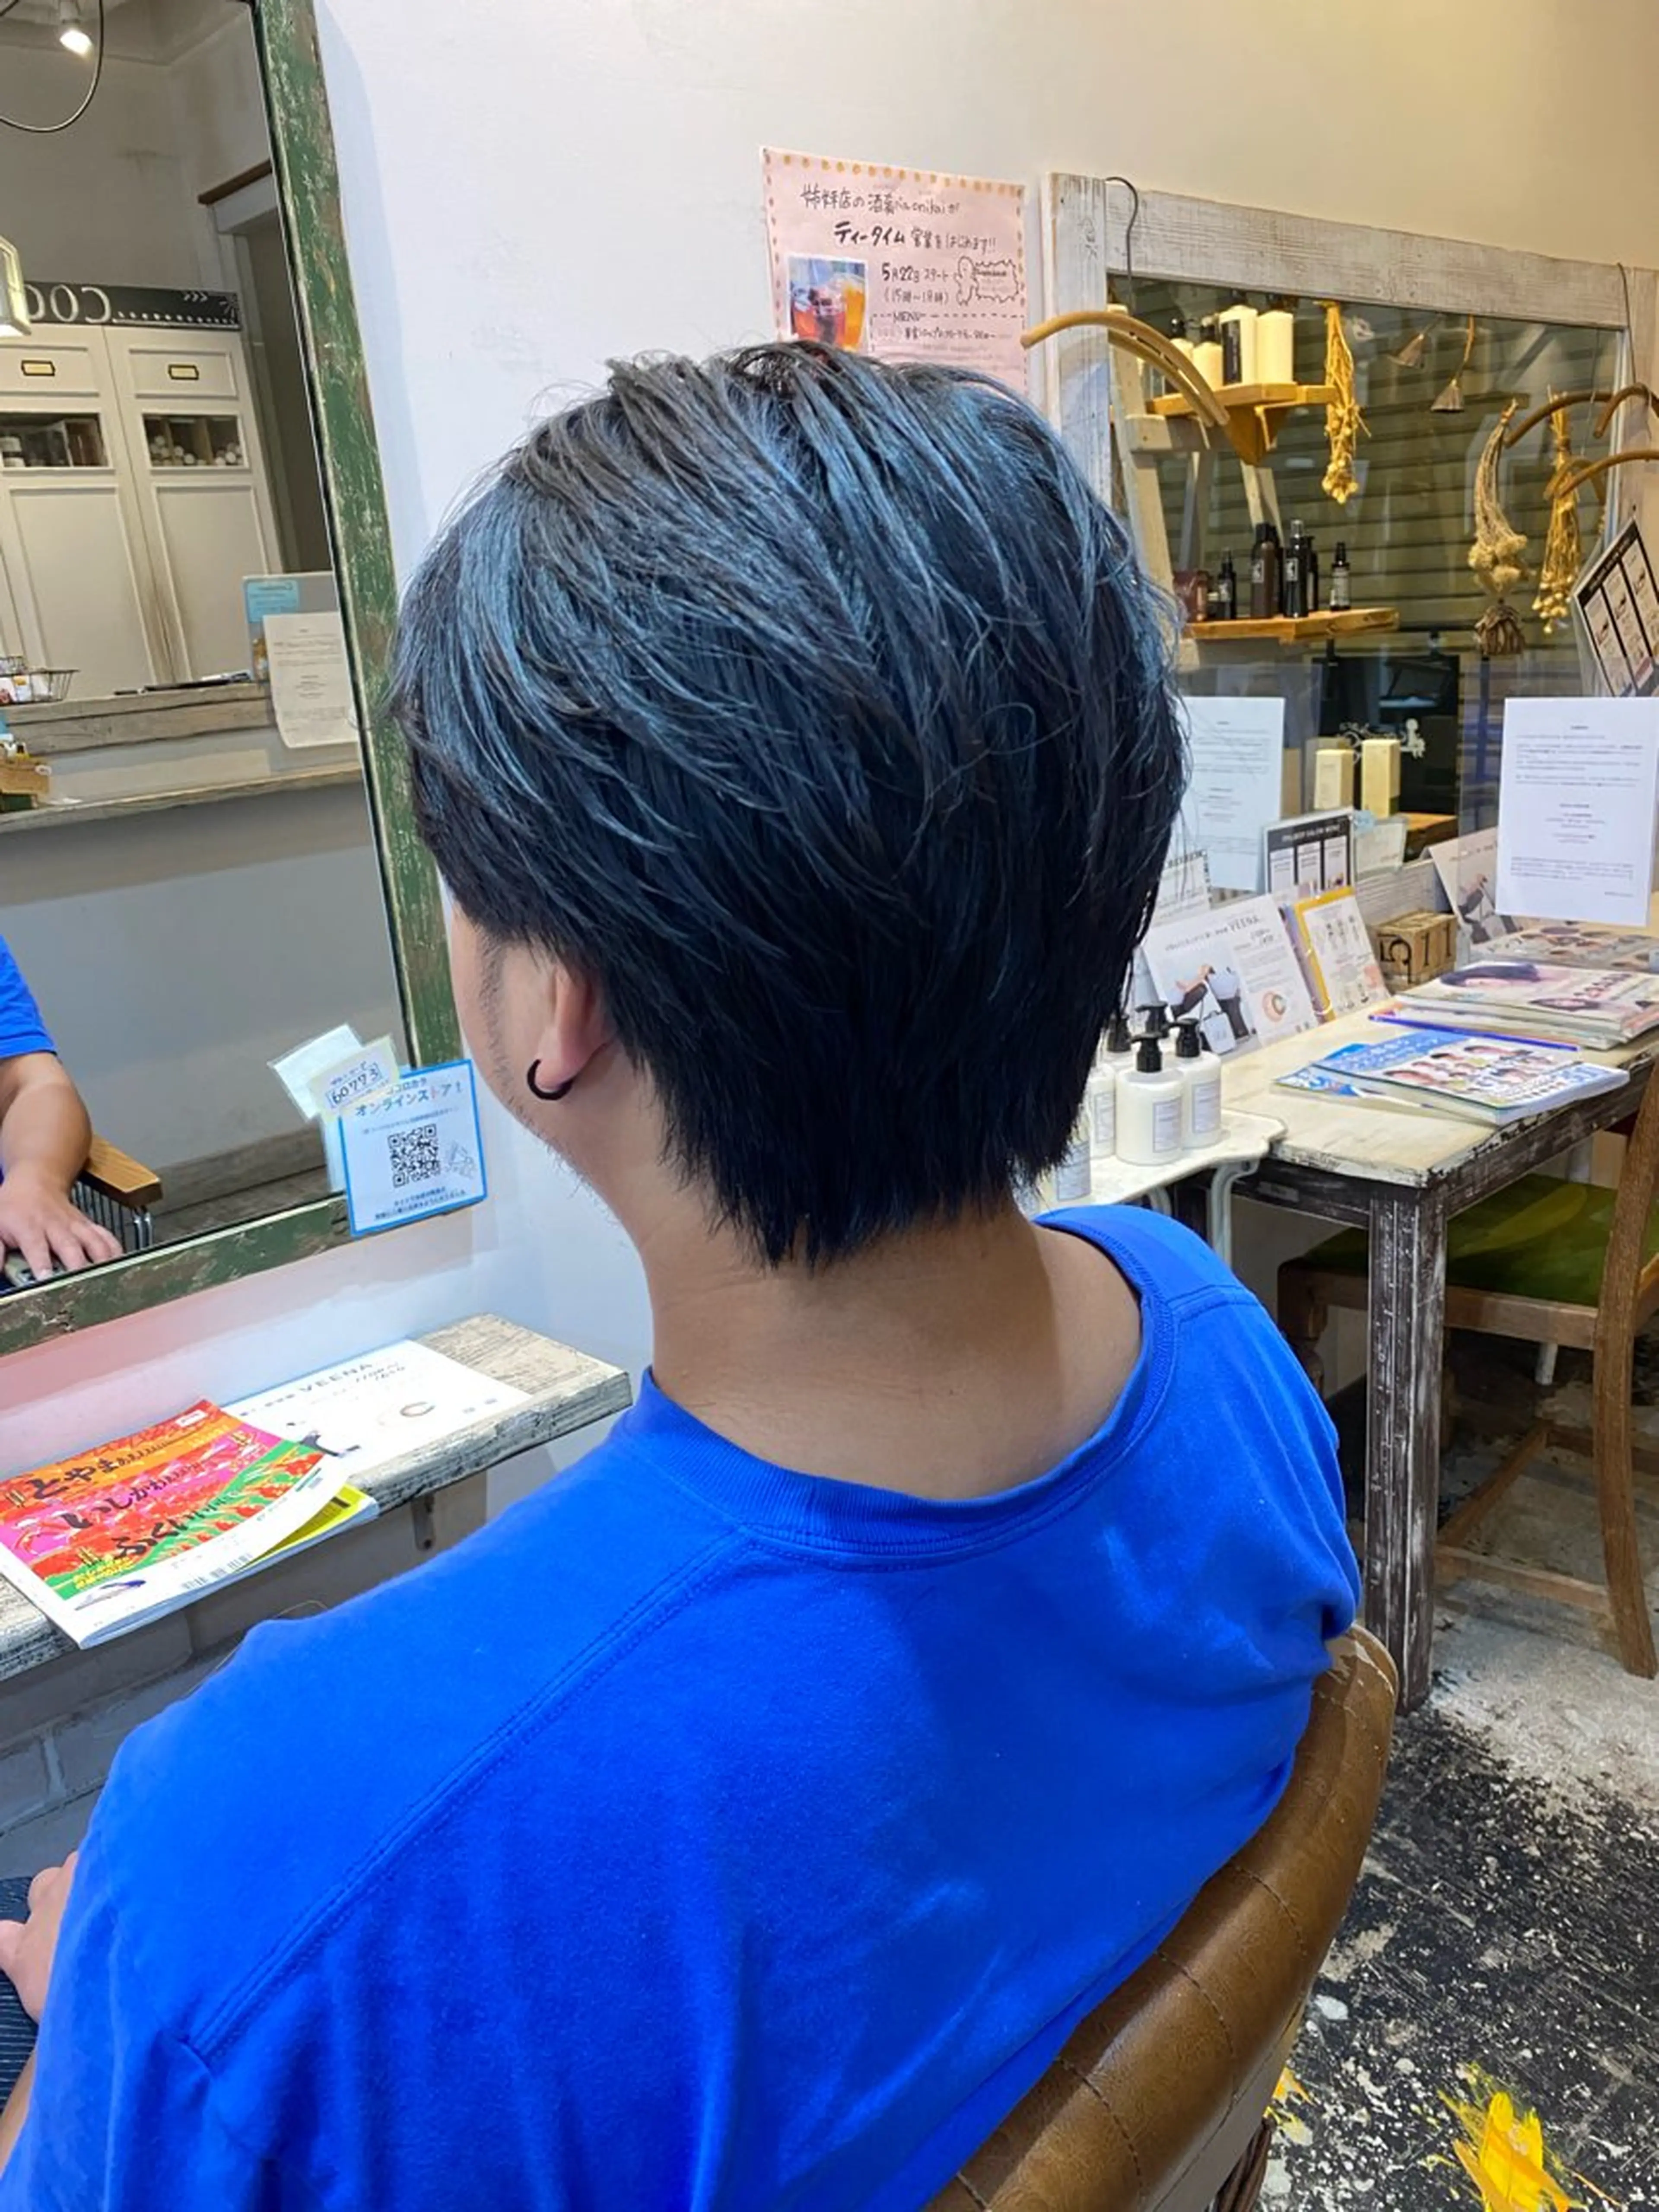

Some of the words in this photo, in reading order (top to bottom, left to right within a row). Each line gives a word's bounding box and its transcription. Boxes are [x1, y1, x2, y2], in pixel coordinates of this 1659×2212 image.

[834, 221, 905, 246] ティータイム
